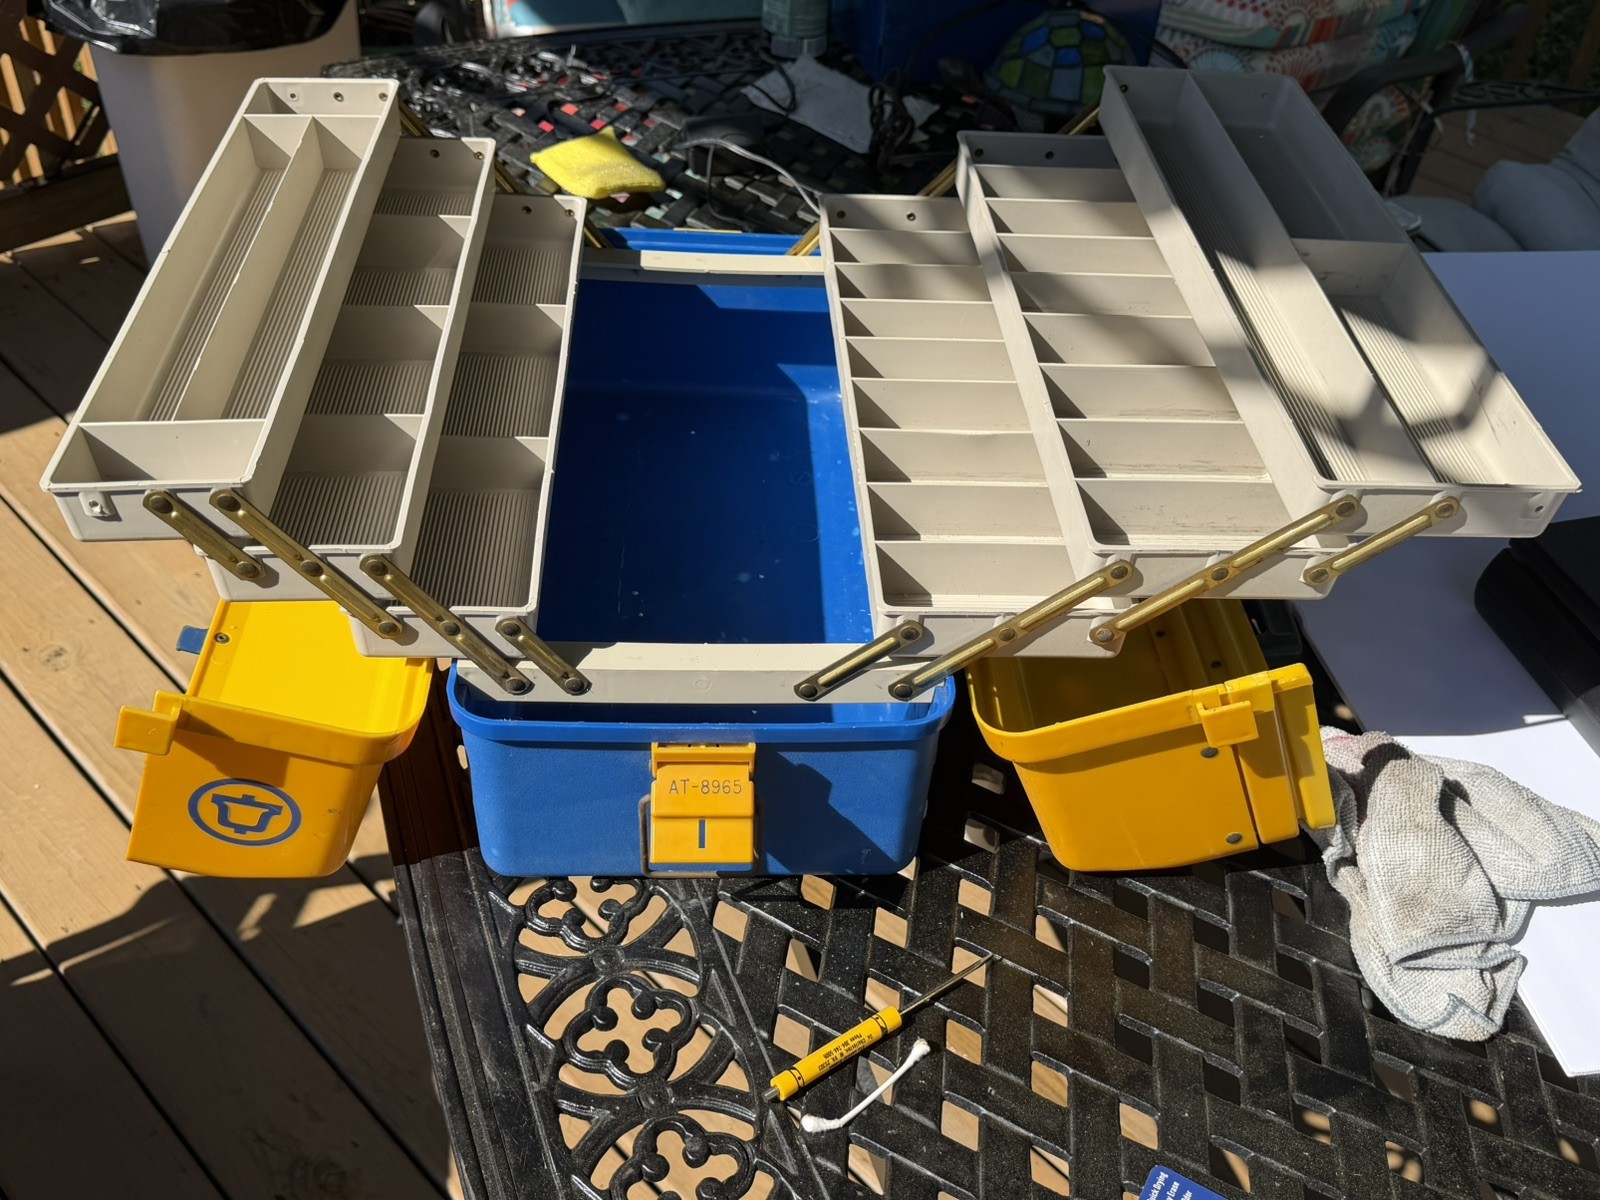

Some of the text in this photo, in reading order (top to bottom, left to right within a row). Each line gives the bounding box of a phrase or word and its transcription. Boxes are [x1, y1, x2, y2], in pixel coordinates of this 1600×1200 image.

[668, 778, 742, 795] AT-8965
[1153, 1171, 1169, 1190] Drying
[1166, 1181, 1180, 1197] Erase
